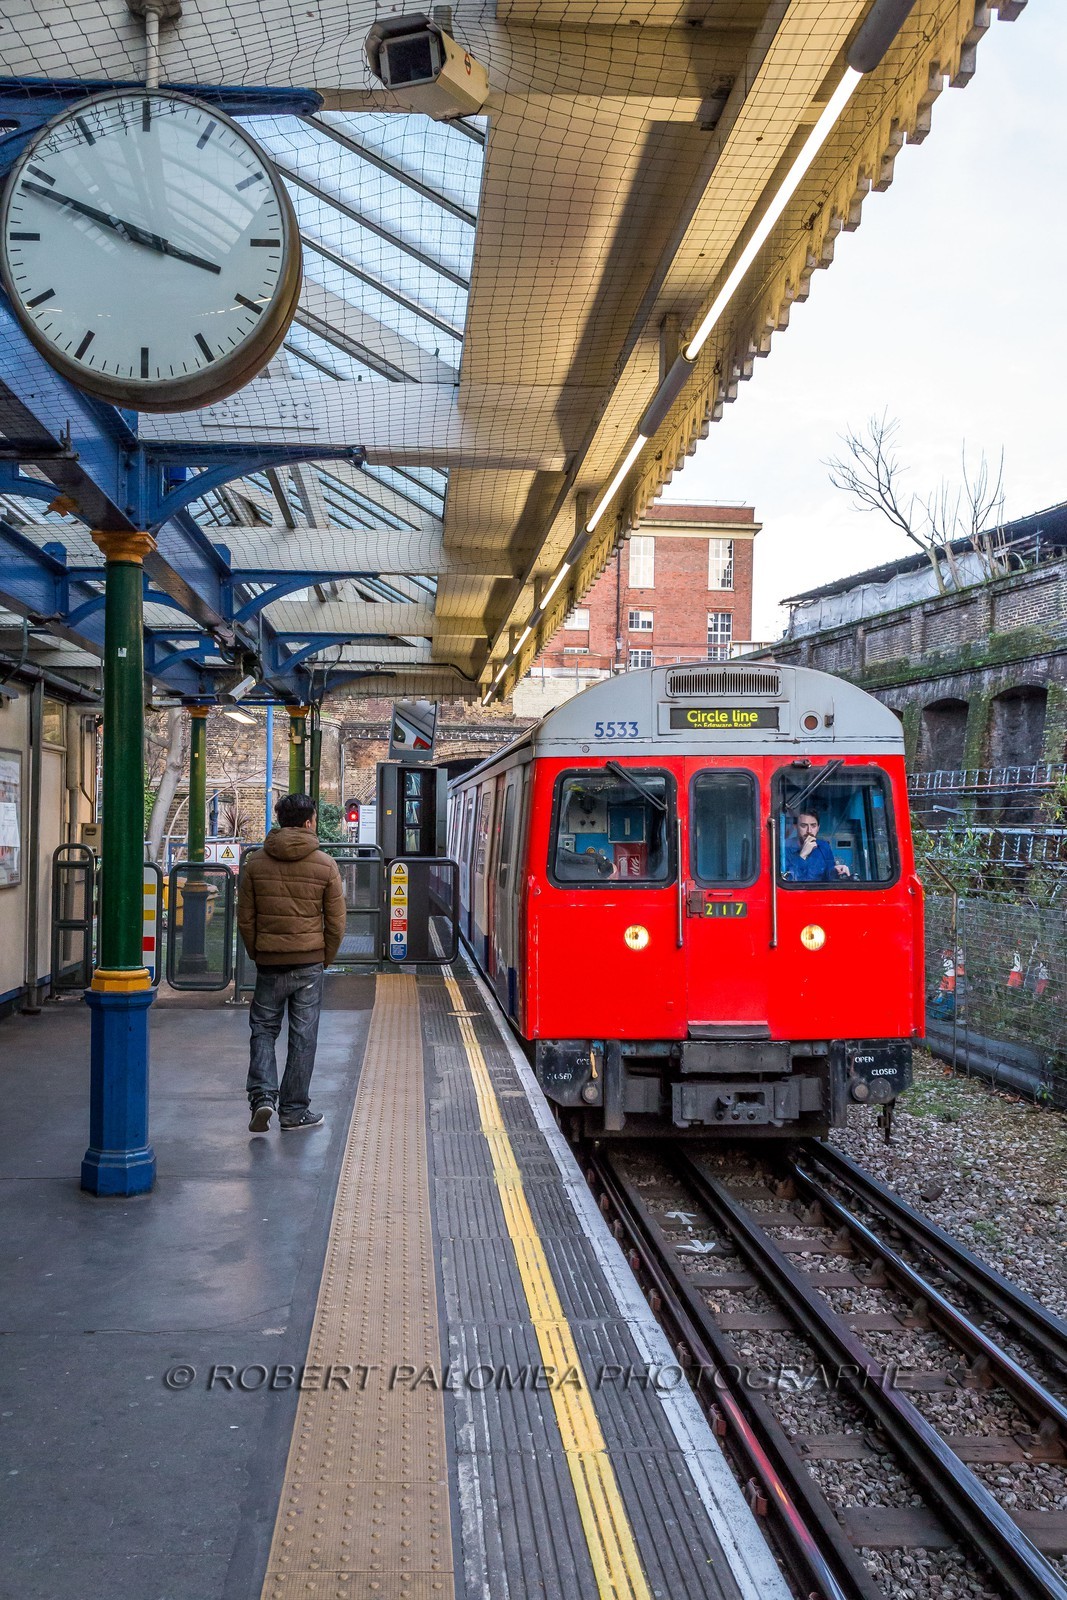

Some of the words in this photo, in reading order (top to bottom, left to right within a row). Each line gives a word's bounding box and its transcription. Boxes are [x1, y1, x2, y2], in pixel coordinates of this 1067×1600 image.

[686, 709, 729, 723] Circle
[732, 709, 759, 722] line
[594, 721, 639, 738] 5533
[854, 1056, 875, 1064] OPEN
[871, 1067, 898, 1076] CLOSED
